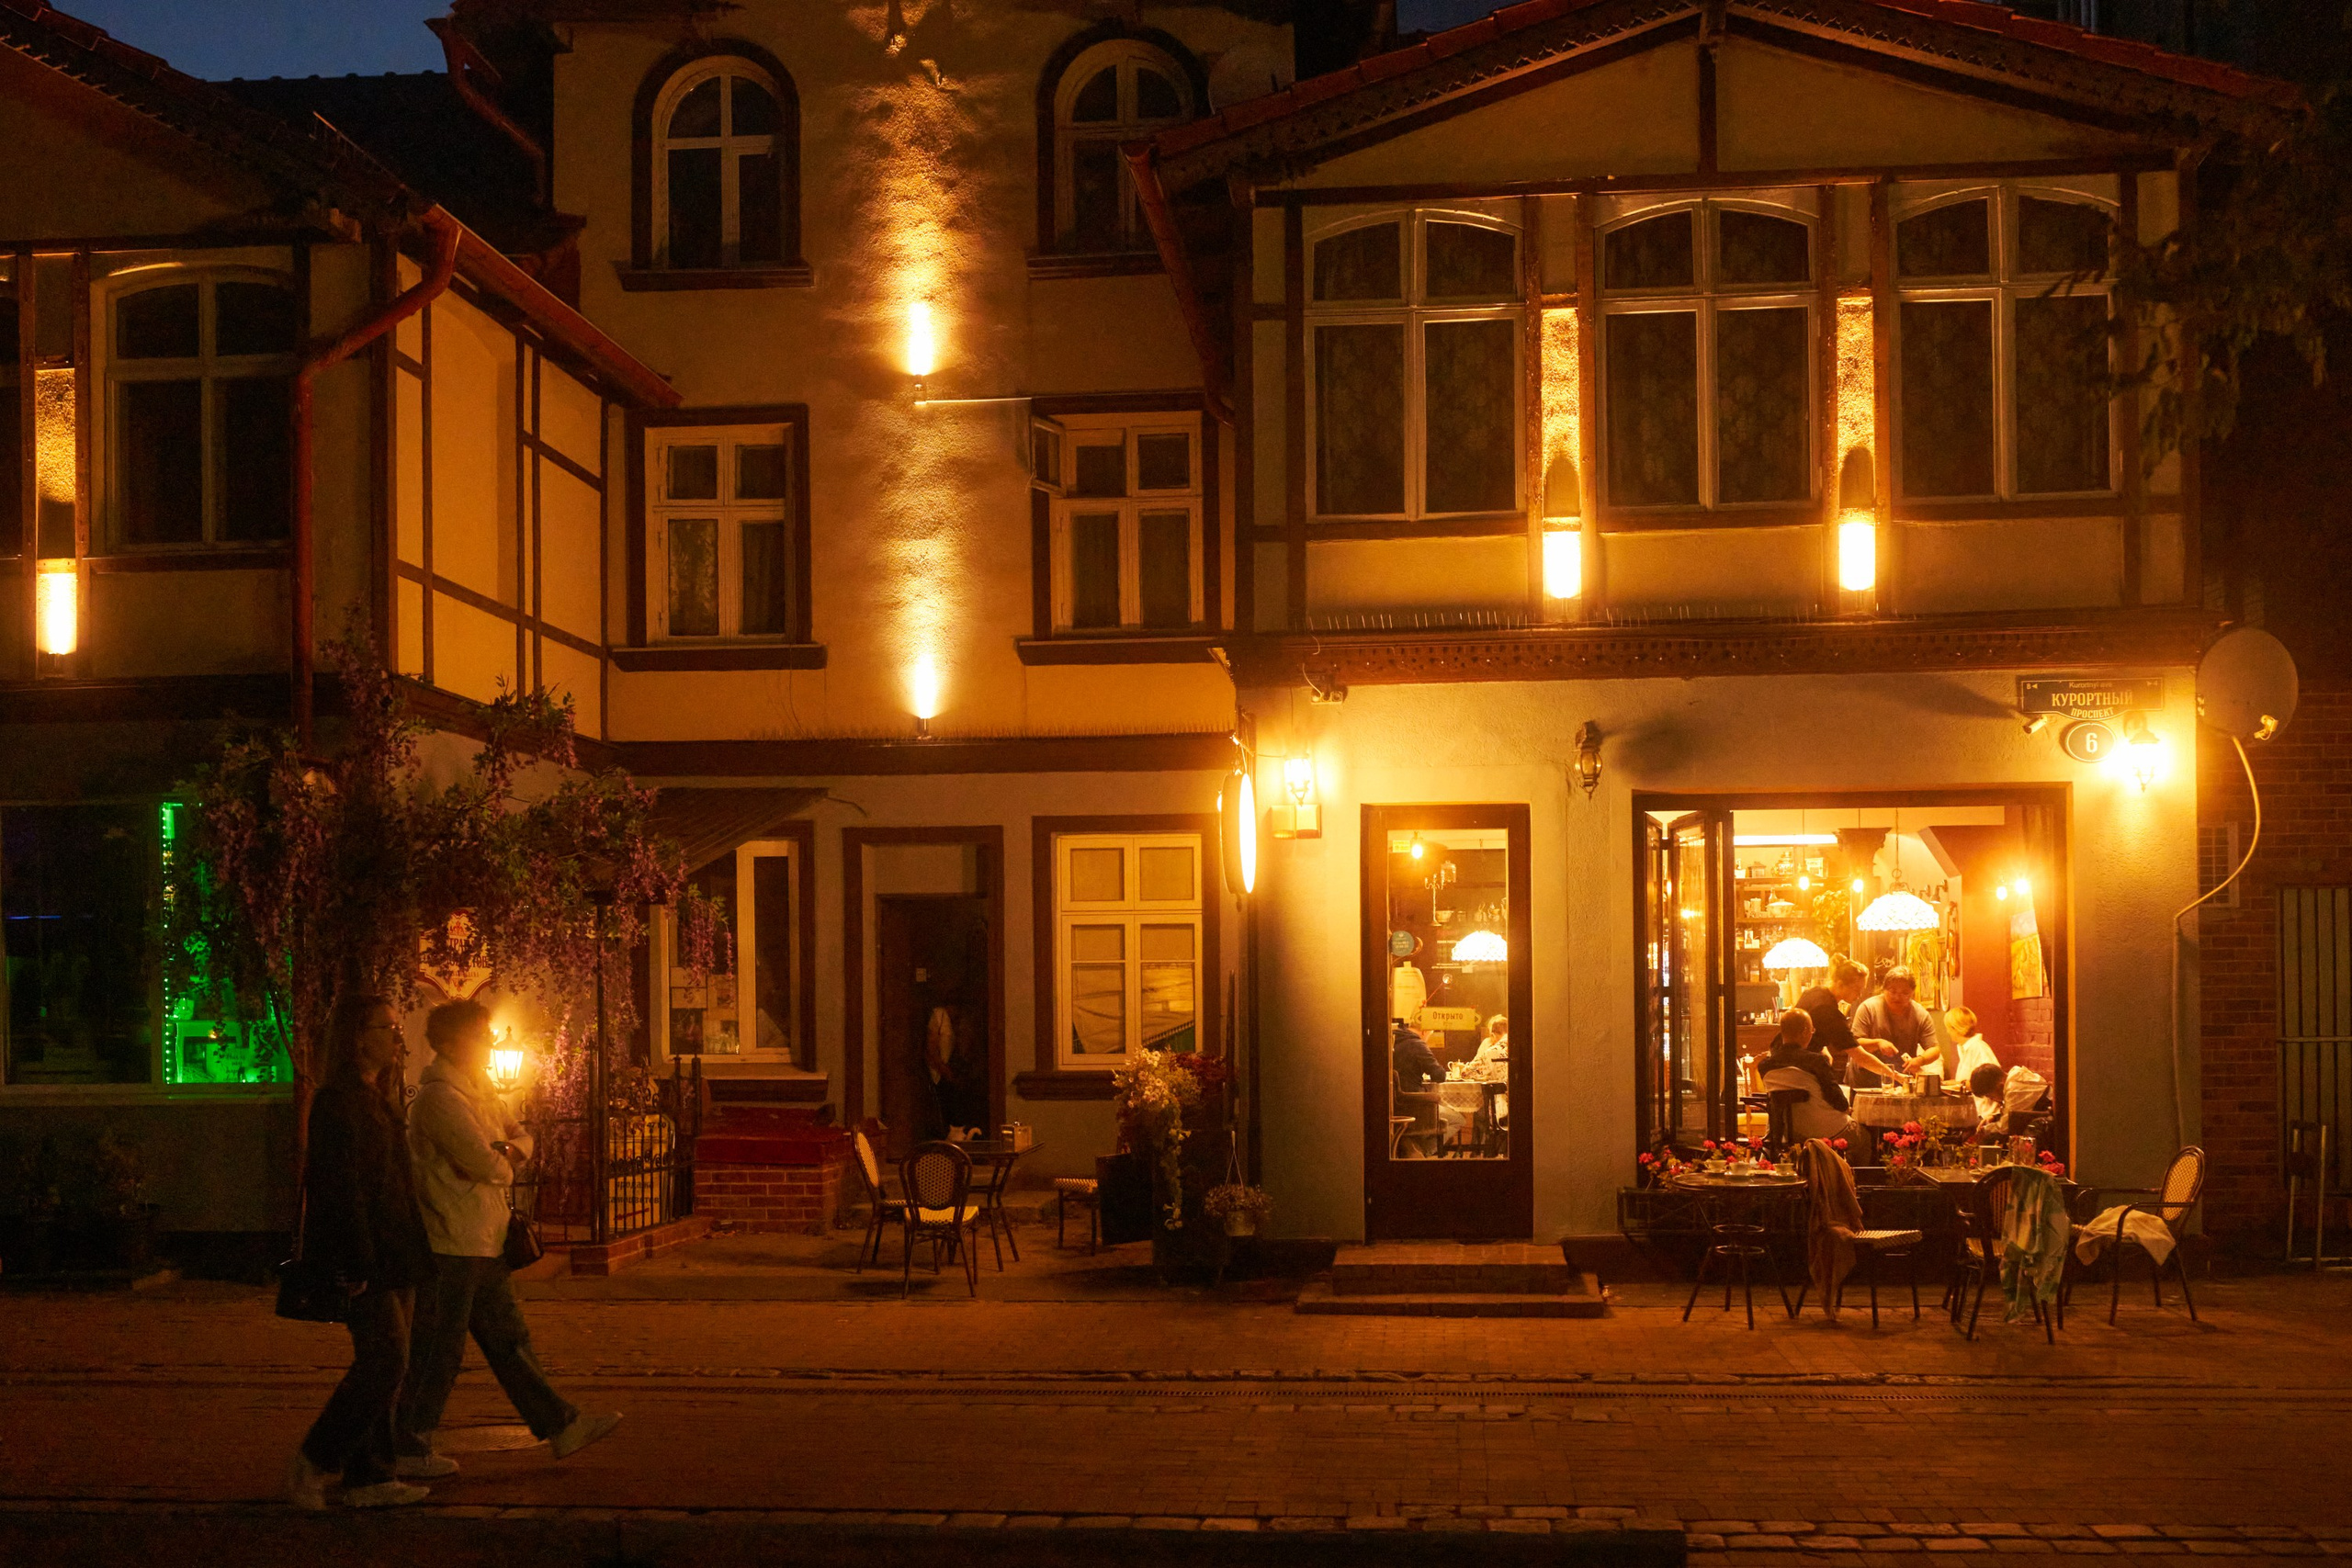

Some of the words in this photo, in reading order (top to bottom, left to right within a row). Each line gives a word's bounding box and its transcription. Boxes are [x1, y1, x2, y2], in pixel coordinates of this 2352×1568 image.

[2052, 690, 2133, 706] КУРОРТНЫЙ
[2071, 706, 2114, 718] ПРОСПЕКТ
[2086, 732, 2098, 753] 6
[1432, 1011, 1464, 1021] Открыто
